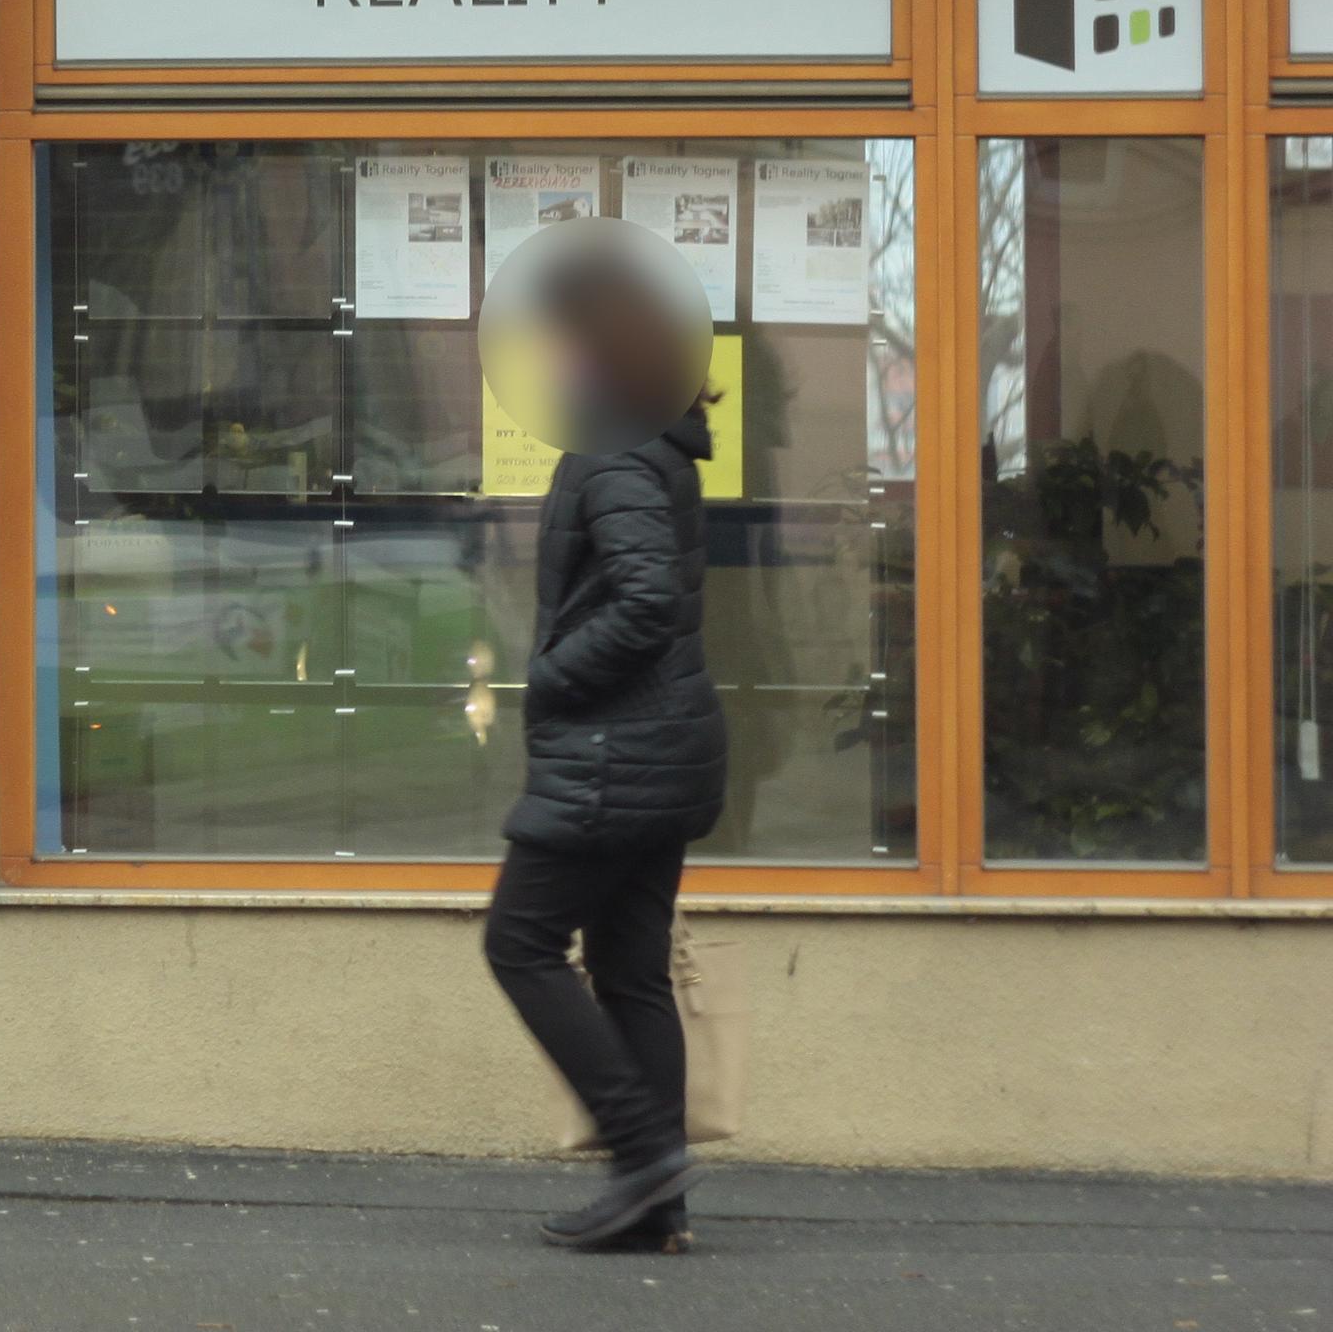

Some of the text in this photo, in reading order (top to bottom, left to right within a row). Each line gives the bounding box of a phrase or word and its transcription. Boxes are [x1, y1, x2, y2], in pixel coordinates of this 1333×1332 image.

[383, 164, 464, 179] Reality Togner
[512, 163, 593, 179] Reality Togner
[649, 164, 731, 180] Reality Togner
[782, 167, 821, 182] Reality
